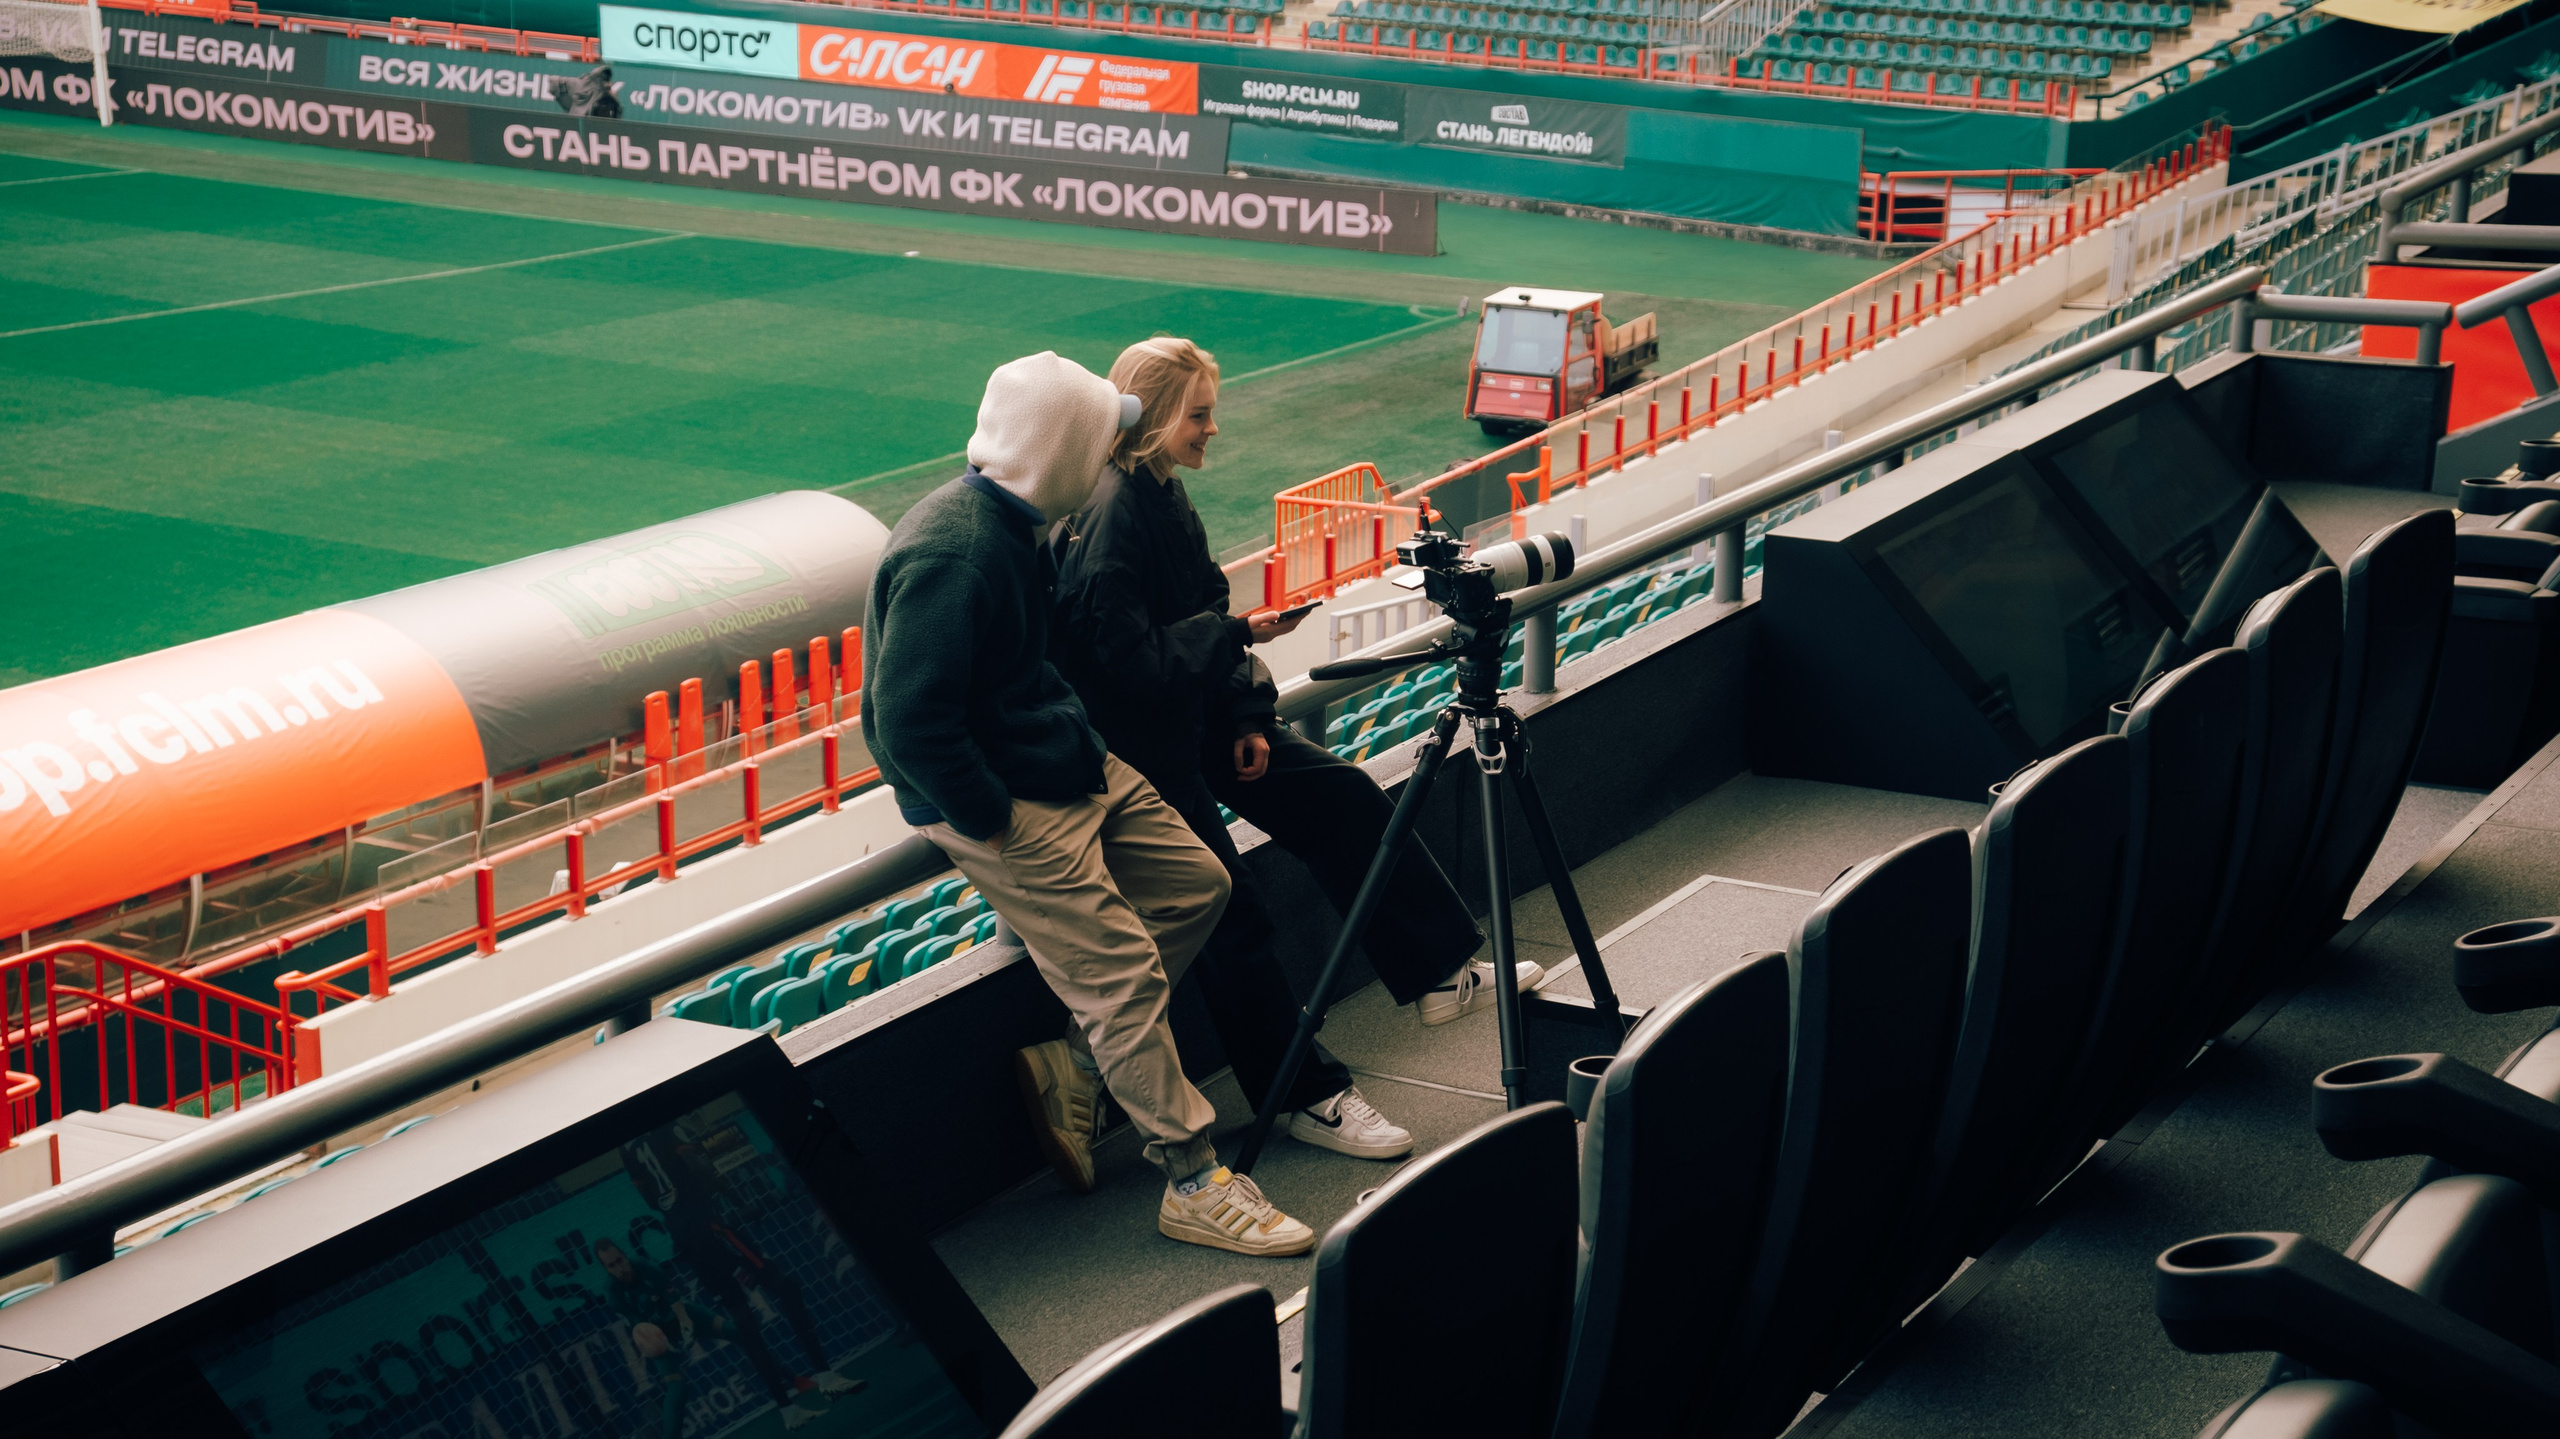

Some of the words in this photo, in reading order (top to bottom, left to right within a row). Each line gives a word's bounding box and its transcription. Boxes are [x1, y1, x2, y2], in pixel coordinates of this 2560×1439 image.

[118, 28, 295, 74] TELEGRAM
[809, 33, 985, 89] САПСАН
[358, 55, 431, 88] ВСЯ
[1099, 79, 1146, 95] грузовая
[1100, 60, 1170, 81] Федеральная
[1099, 96, 1150, 112] компания
[1242, 80, 1360, 109] SHOP.FCLM.RU
[127, 83, 435, 145] «ЛОКОМОТИВ»
[630, 85, 890, 130] «ЛОКОМОТИВ»
[898, 107, 946, 137] VK
[953, 112, 982, 142] И
[987, 115, 1190, 159] TELEGRAM
[1203, 98, 1245, 115] Игровая
[1246, 103, 1281, 120] форма
[1286, 107, 1346, 126] Атрибутика
[1352, 115, 1399, 132] Подарки
[1436, 120, 1494, 143] СТАНЬ
[1495, 126, 1594, 155] ЛЕГЕНДОЙ!
[503, 124, 651, 171] СТАНЬ
[658, 139, 941, 199] ПАРТНЁРОМ
[950, 169, 1025, 208] ФК
[1032, 177, 1393, 238] «ЛОКОМОТИВ»
[600, 623, 706, 672] программа
[706, 593, 810, 639] лояльности
